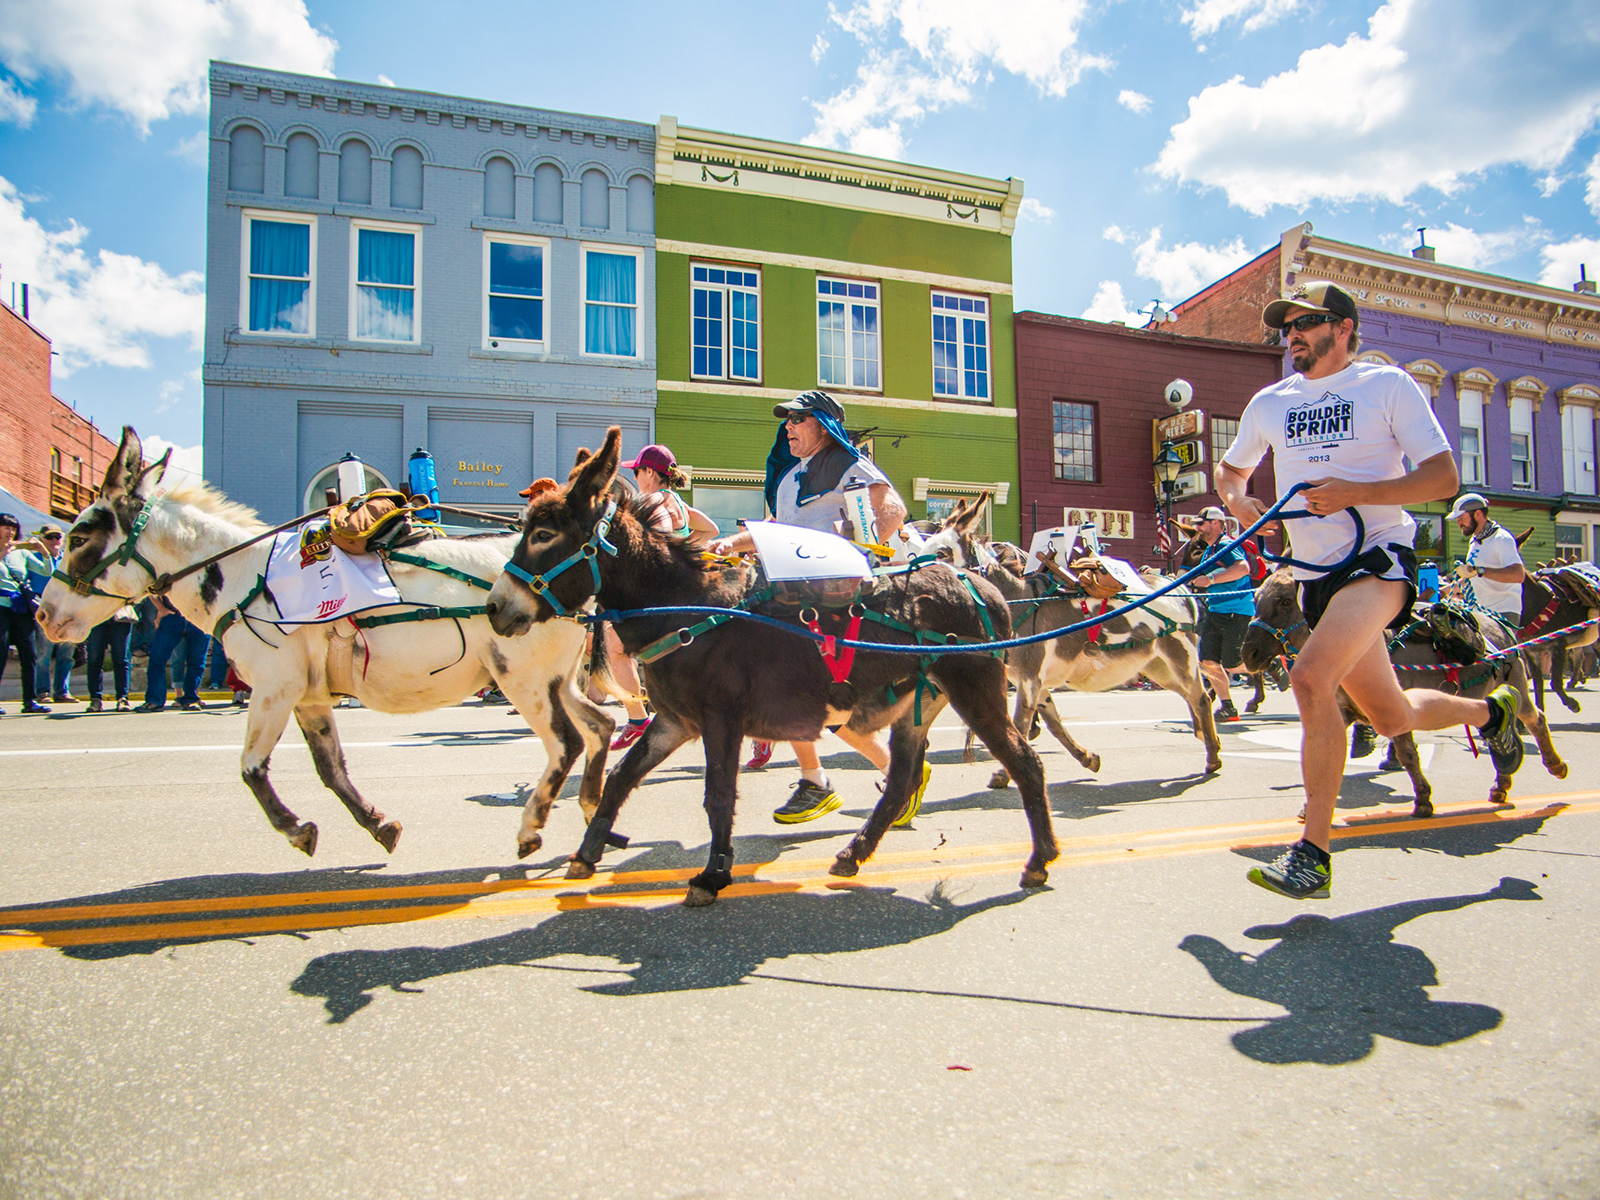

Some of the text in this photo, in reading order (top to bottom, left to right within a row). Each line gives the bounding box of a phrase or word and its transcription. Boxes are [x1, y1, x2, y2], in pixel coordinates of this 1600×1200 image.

[1287, 403, 1351, 424] BOULDER
[1286, 415, 1351, 439] SPRINT
[1292, 432, 1344, 445] TRIATHLON
[1308, 454, 1331, 463] 2013
[458, 461, 503, 475] Bailey
[453, 478, 509, 487] Funeral Home
[1067, 509, 1130, 537] GIFT
